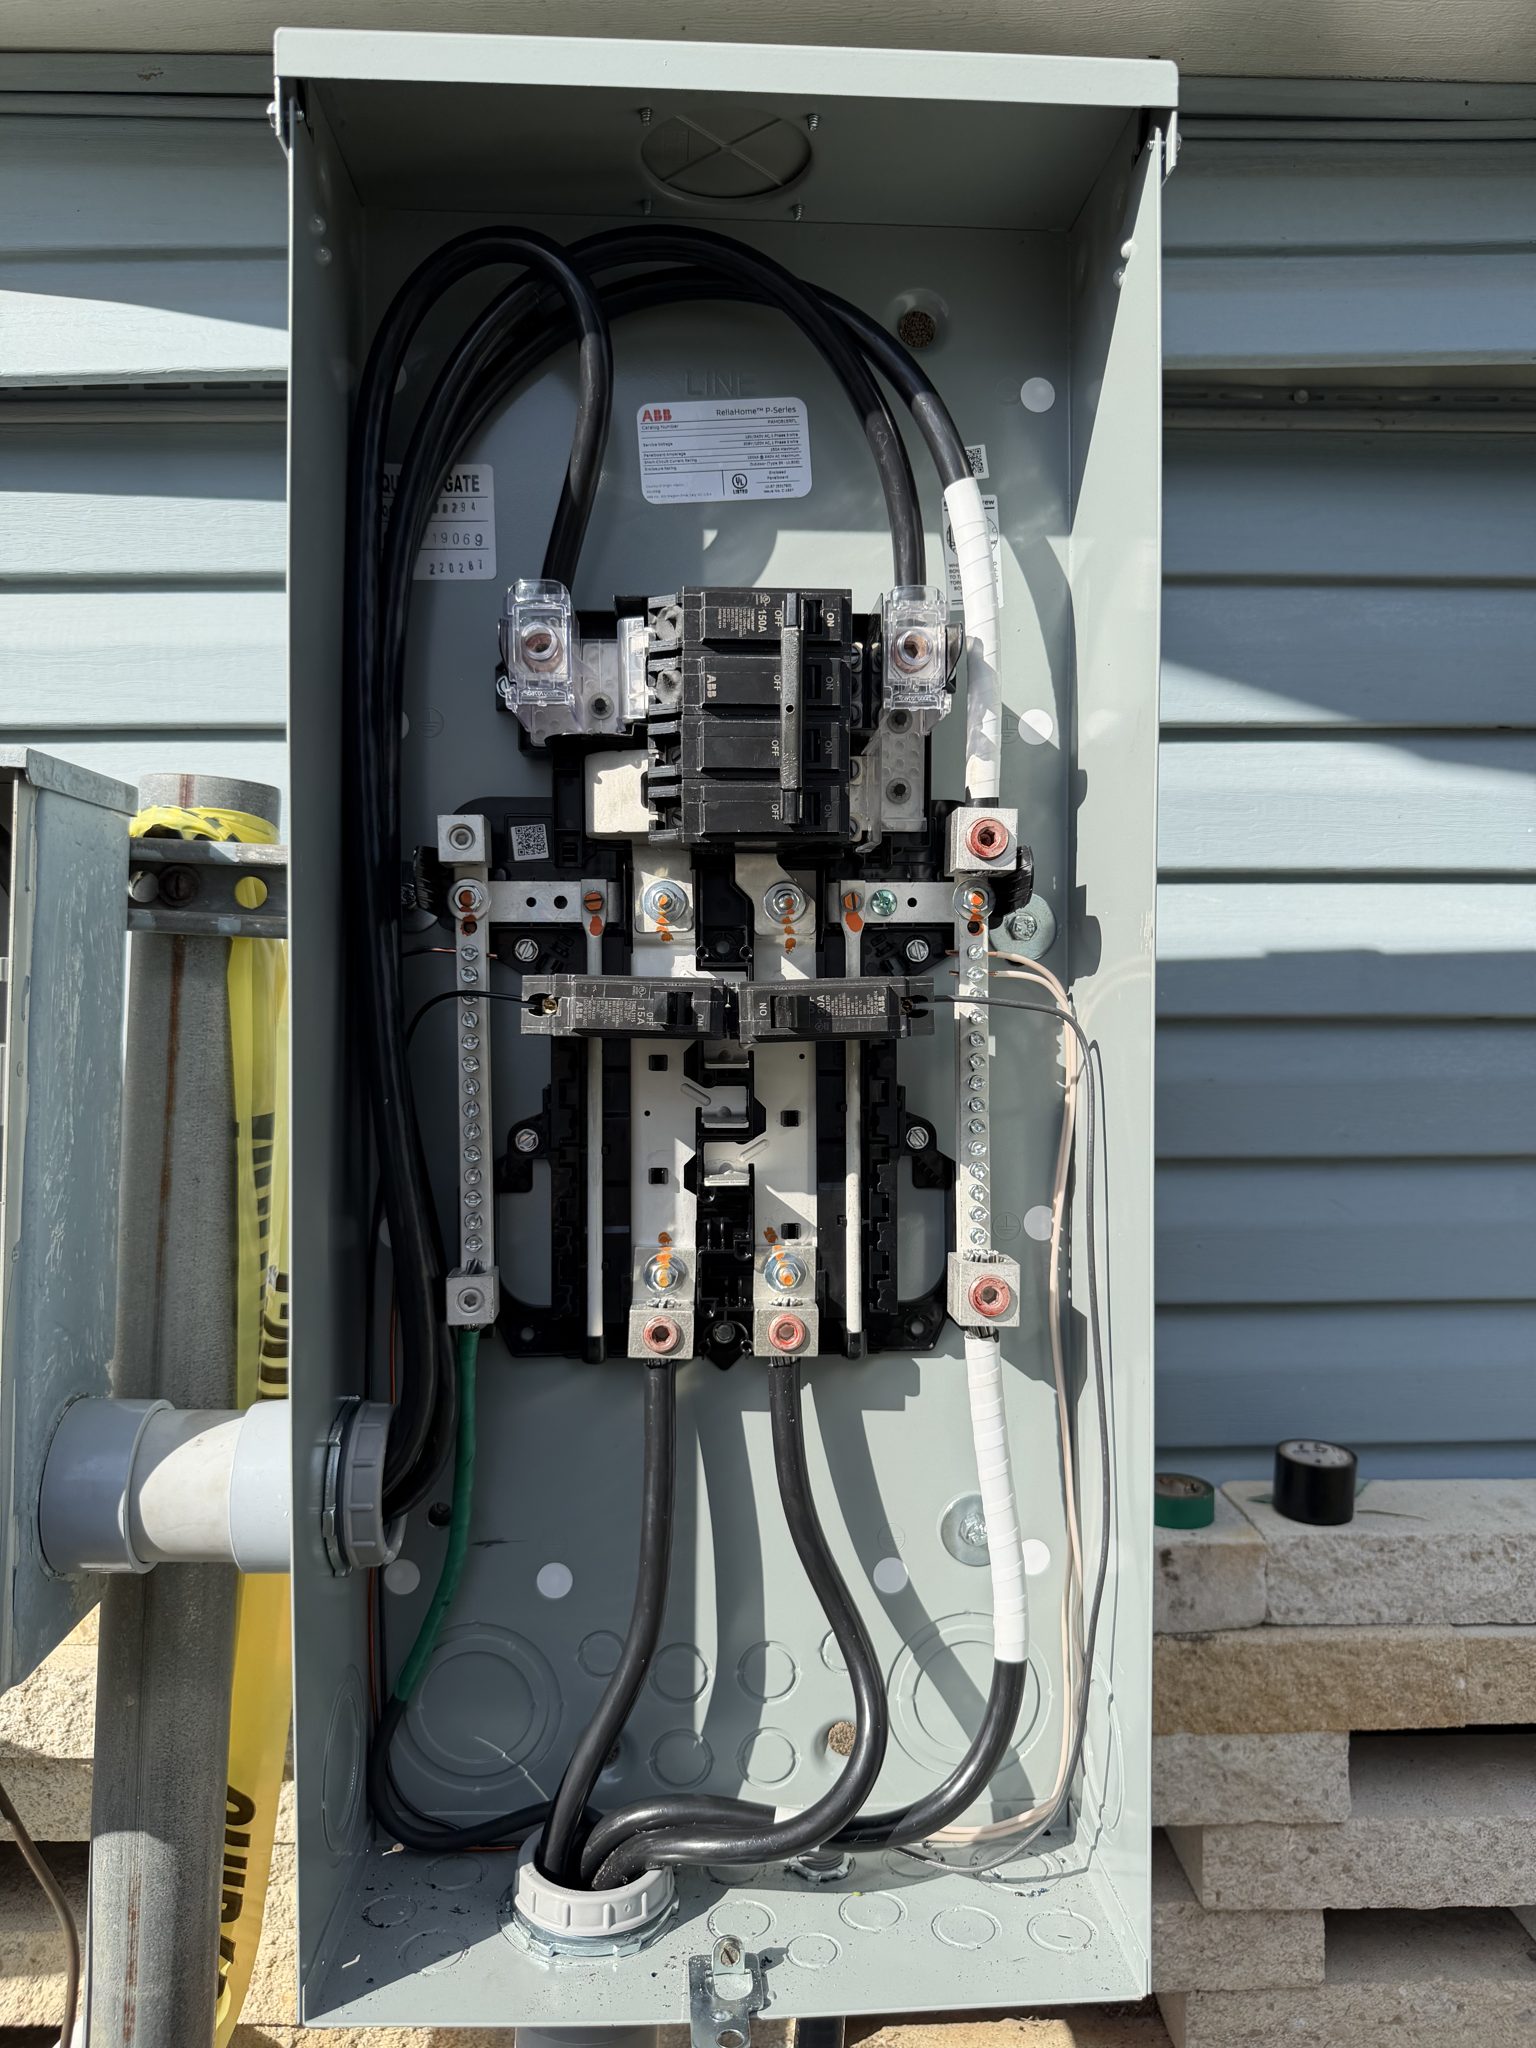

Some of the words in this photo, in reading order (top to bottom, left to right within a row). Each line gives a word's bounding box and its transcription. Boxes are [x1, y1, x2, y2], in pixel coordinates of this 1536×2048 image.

[642, 408, 672, 422] ABB
[765, 406, 797, 414] P-Series
[444, 474, 480, 493] GATE
[758, 609, 767, 633] 150A
[826, 612, 835, 627] ON
[706, 674, 717, 698] ABB
[826, 676, 833, 690] ON
[825, 740, 832, 754] ON
[824, 804, 832, 819] ON
[759, 1002, 767, 1016] ON
[817, 995, 825, 1014] 20A
[637, 1006, 645, 1025] 15A
[697, 1014, 704, 1026] ON
